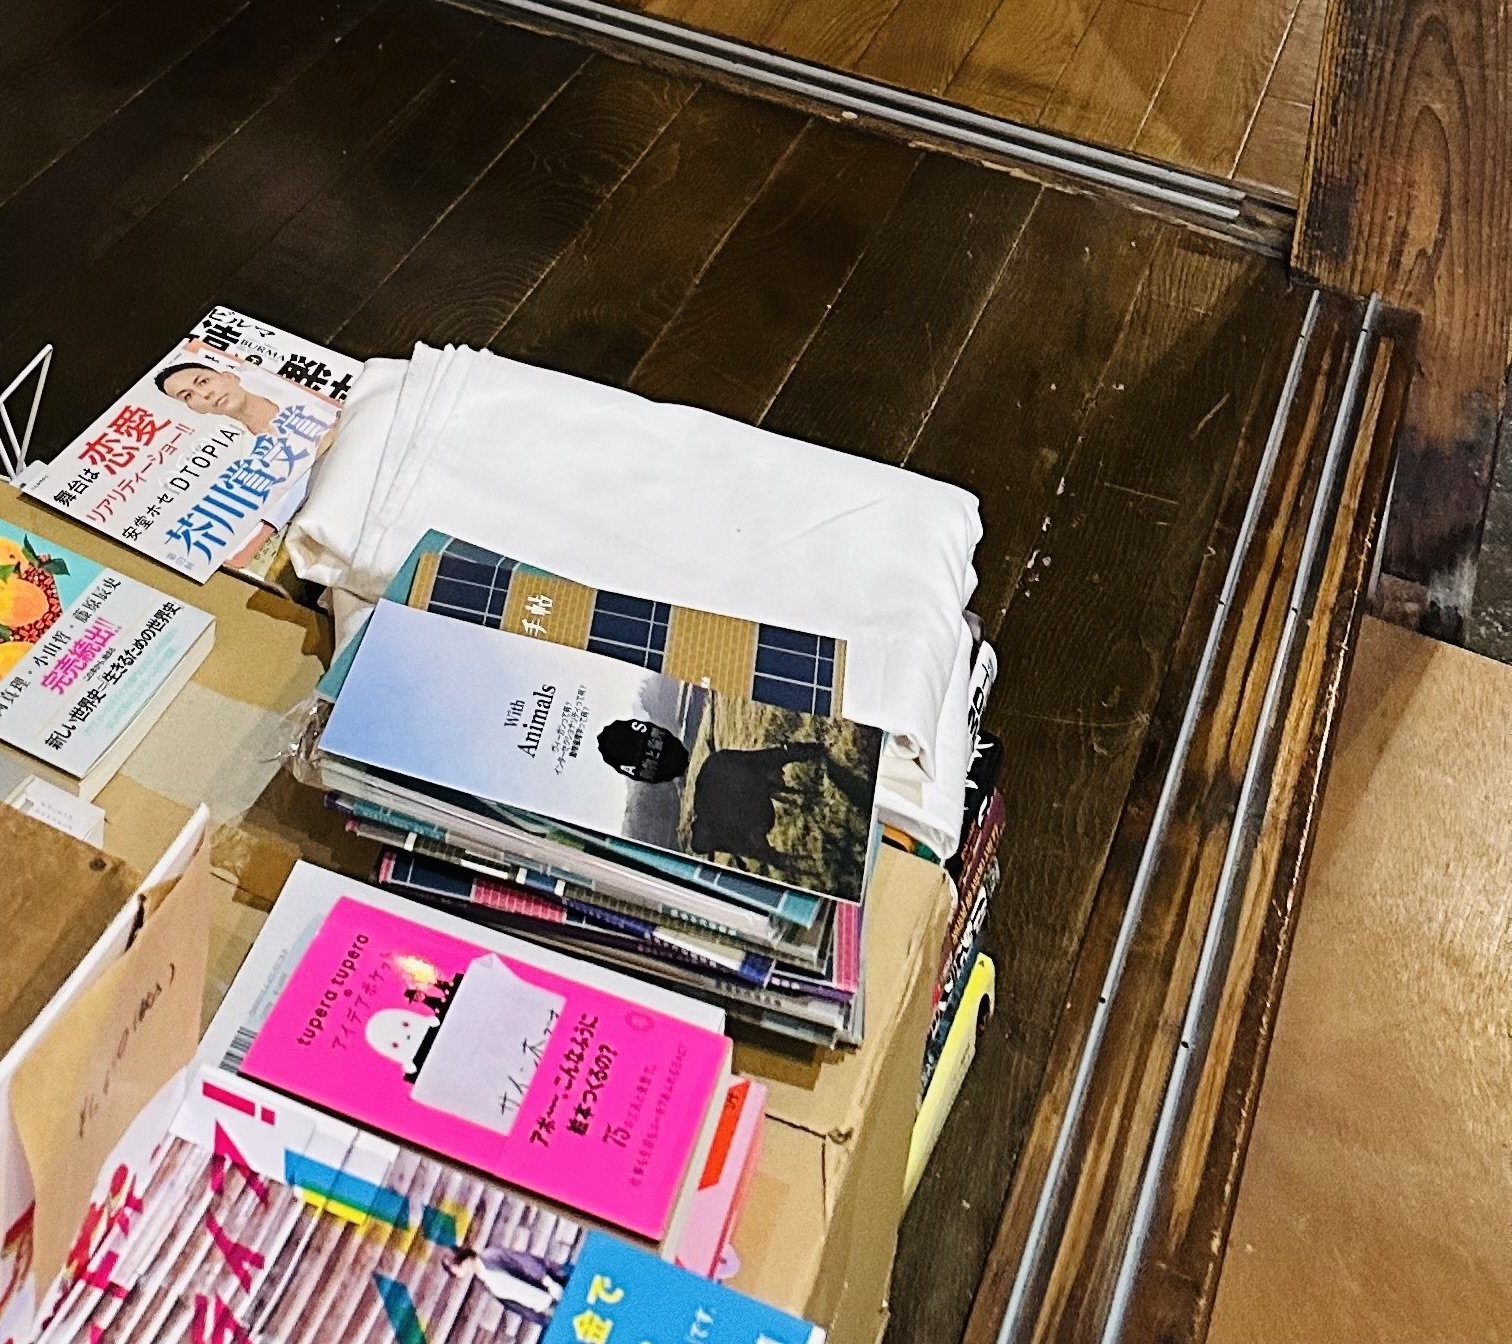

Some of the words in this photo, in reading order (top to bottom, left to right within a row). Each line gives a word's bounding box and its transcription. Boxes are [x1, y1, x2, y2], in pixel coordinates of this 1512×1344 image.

[78, 403, 171, 476] 恋愛
[165, 401, 342, 565] 芥川賞受賞
[503, 697, 526, 730] With
[516, 680, 557, 759] Animals
